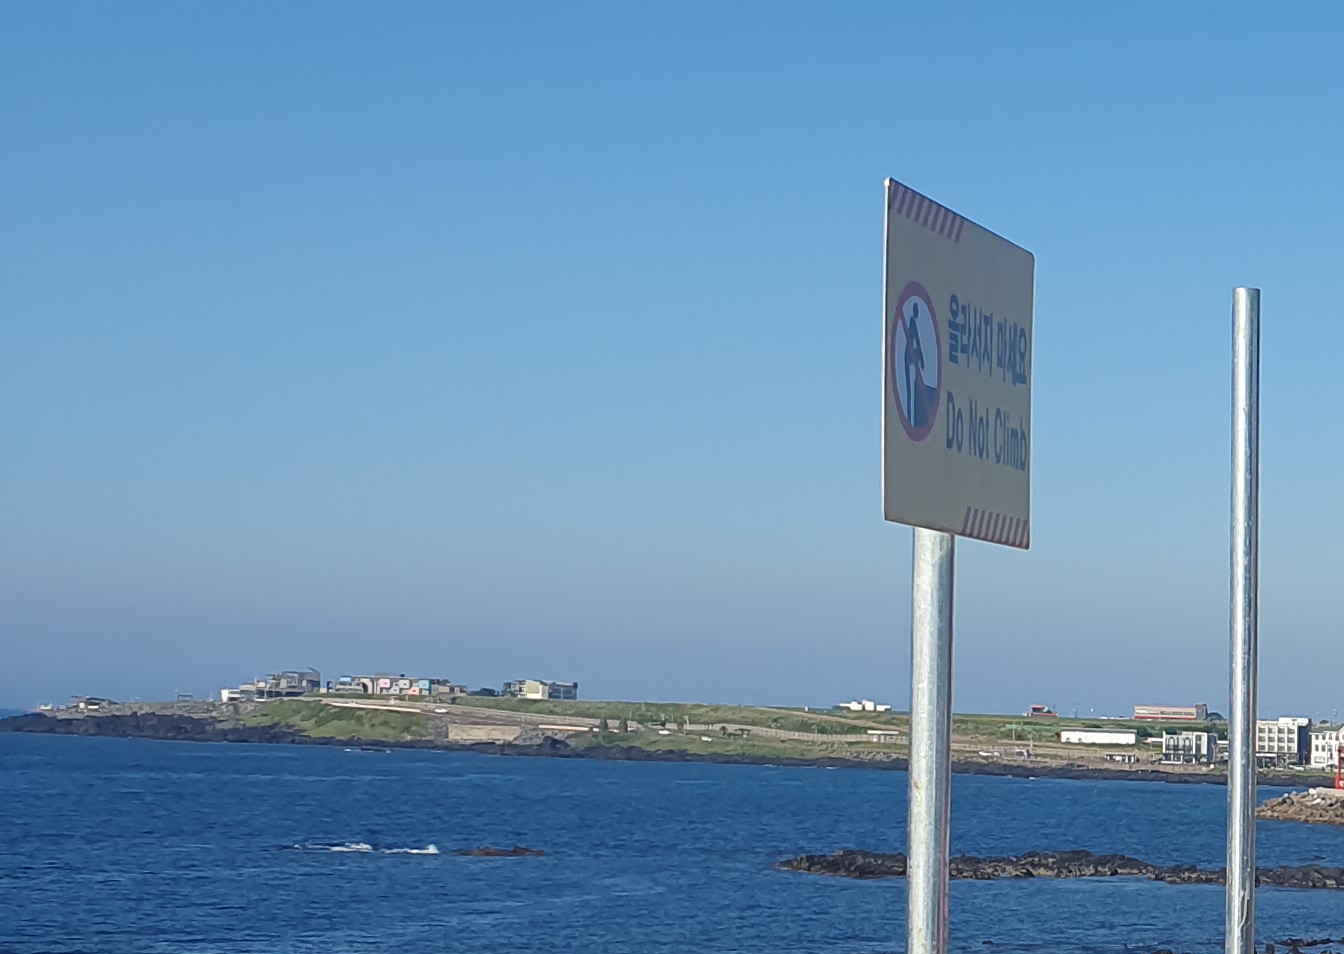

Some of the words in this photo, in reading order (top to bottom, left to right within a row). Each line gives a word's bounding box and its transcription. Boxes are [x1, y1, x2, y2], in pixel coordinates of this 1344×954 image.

[948, 294, 993, 377] 올라서지
[996, 317, 1028, 387] 마세요
[946, 390, 964, 453] Do
[968, 398, 989, 460] Not
[994, 407, 1027, 472] Climb
